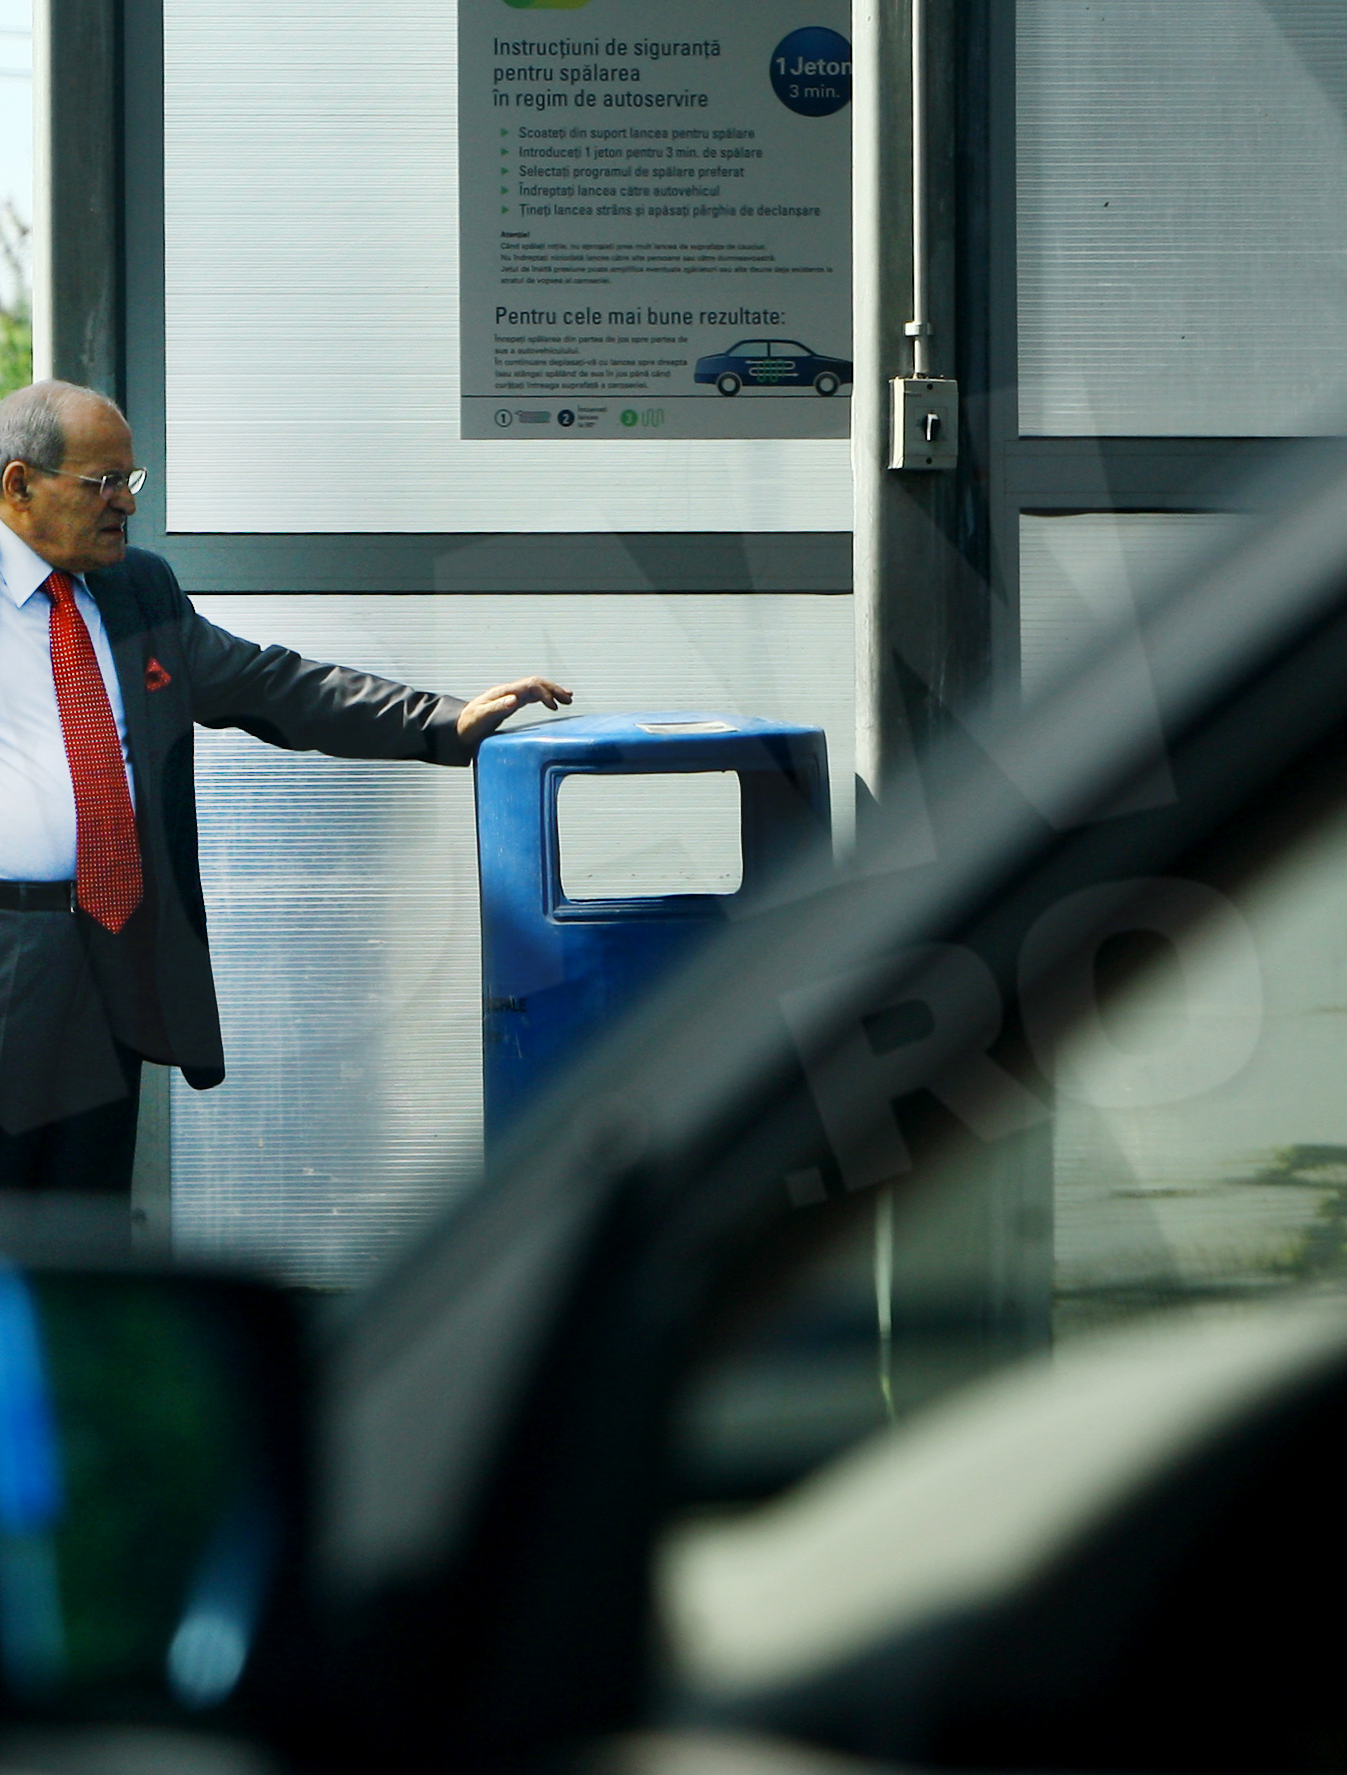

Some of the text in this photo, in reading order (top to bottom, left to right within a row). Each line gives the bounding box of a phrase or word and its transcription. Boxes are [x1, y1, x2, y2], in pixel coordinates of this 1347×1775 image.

[493, 38, 722, 60] Instrucțiuni de siguranță
[776, 56, 852, 76] 1 Jeton
[493, 65, 641, 85] pentru spălarea
[789, 84, 841, 98] 3 min.
[493, 89, 709, 111] în regim de autoservire
[569, 127, 587, 138] din
[590, 128, 627, 140] suport
[629, 127, 669, 138] lancea
[671, 128, 710, 140] pentru
[585, 146, 591, 157] 1
[594, 146, 623, 160] jeton
[626, 147, 664, 160] pentru
[666, 146, 674, 157] 3
[675, 146, 700, 157] min.
[702, 146, 717, 157] de
[572, 165, 633, 179] programul
[634, 165, 649, 177] de
[698, 165, 745, 179] preferat
[577, 185, 617, 196] lancea
[653, 185, 721, 196] autovehicul
[553, 204, 593, 215] lancea
[739, 204, 754, 215] de
[495, 307, 787, 324] Pentru cele mai bune rezultate:
